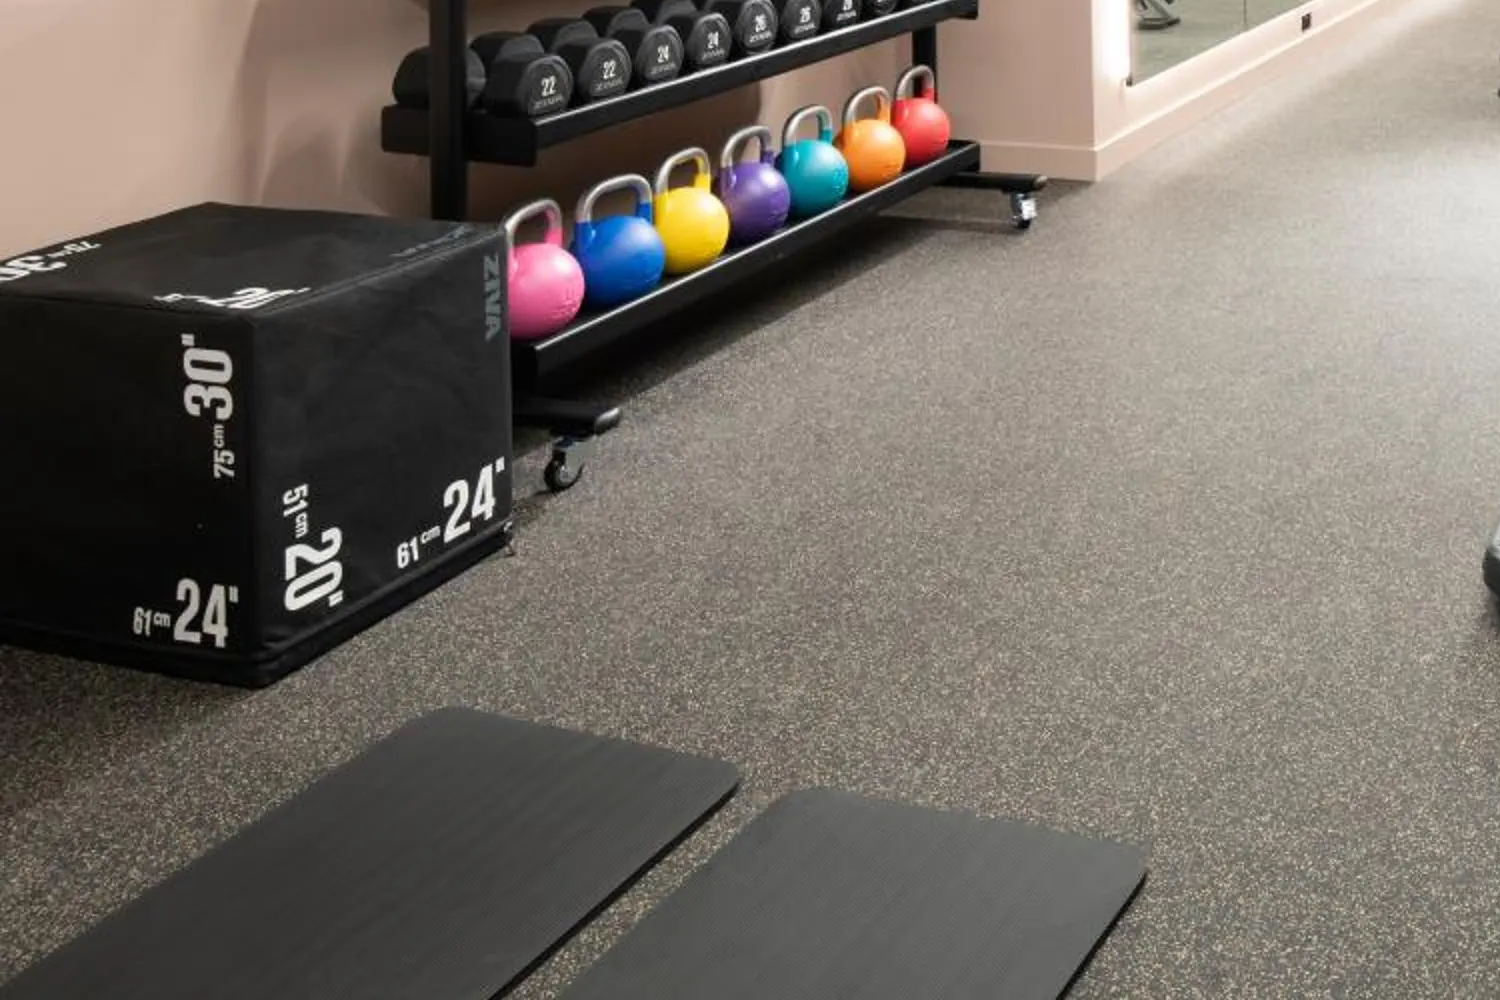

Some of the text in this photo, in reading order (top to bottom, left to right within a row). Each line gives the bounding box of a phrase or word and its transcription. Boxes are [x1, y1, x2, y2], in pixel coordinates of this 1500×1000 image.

[706, 31, 720, 50] 24
[656, 44, 671, 64] 24
[602, 59, 617, 80] 22
[540, 75, 557, 98] 22
[483, 253, 501, 343] ZIVA
